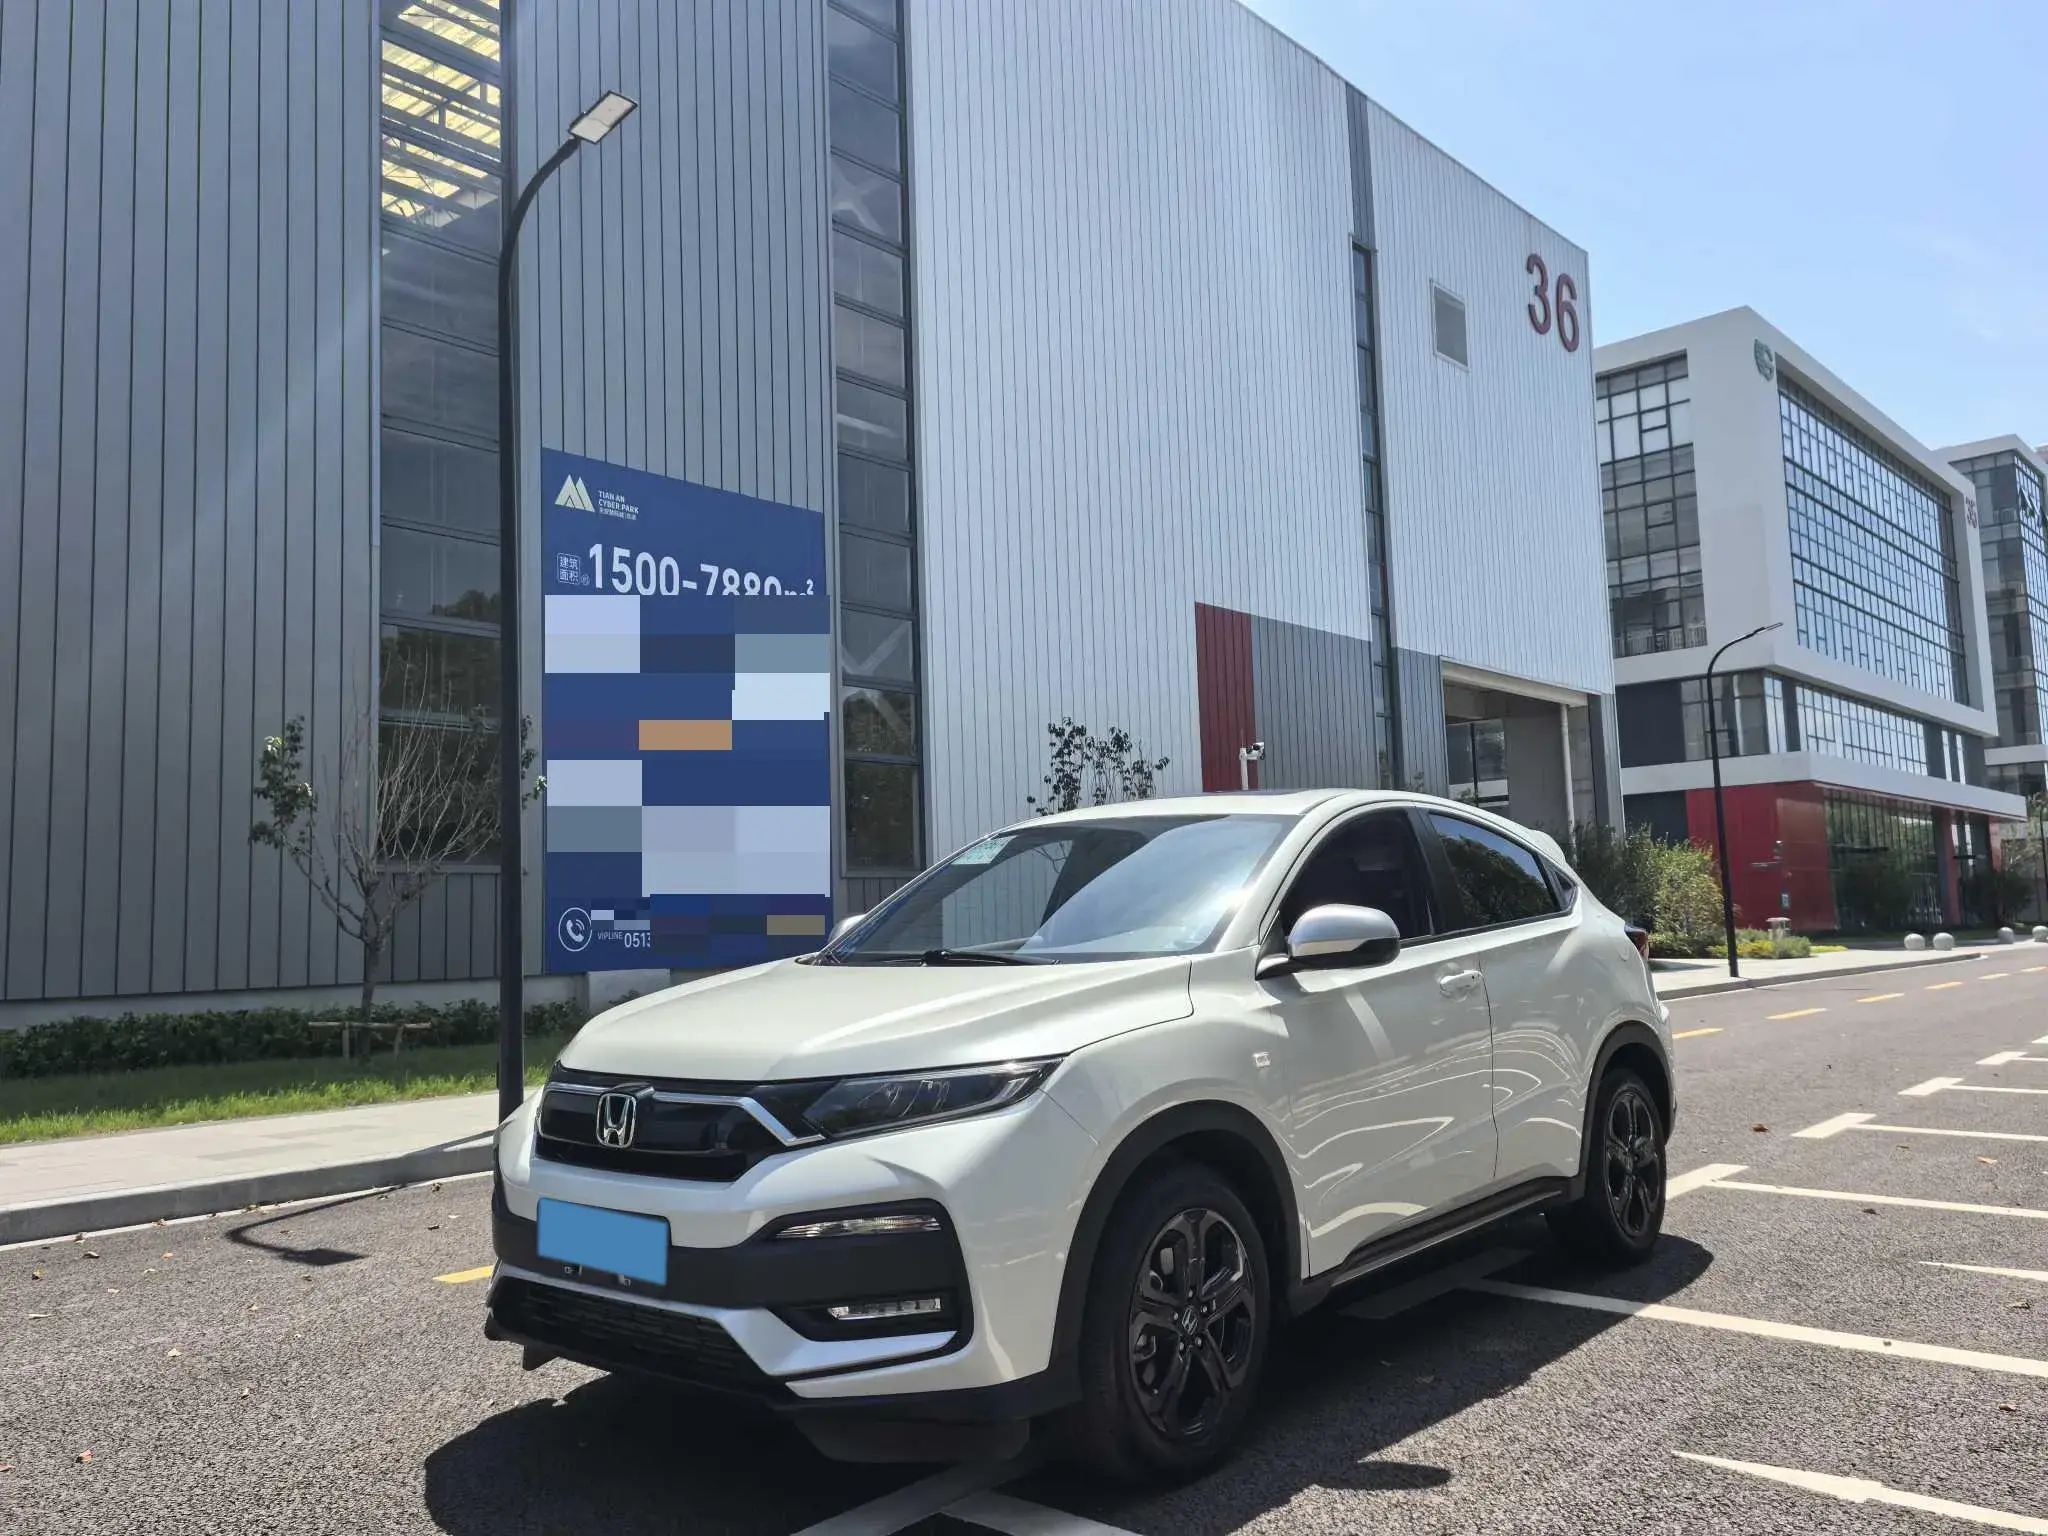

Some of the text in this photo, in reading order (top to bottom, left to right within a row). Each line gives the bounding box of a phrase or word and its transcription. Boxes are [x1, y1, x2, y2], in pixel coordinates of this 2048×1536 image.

[1526, 253, 1579, 353] 36
[598, 490, 625, 503] TIAN AN
[621, 503, 639, 514] PARK
